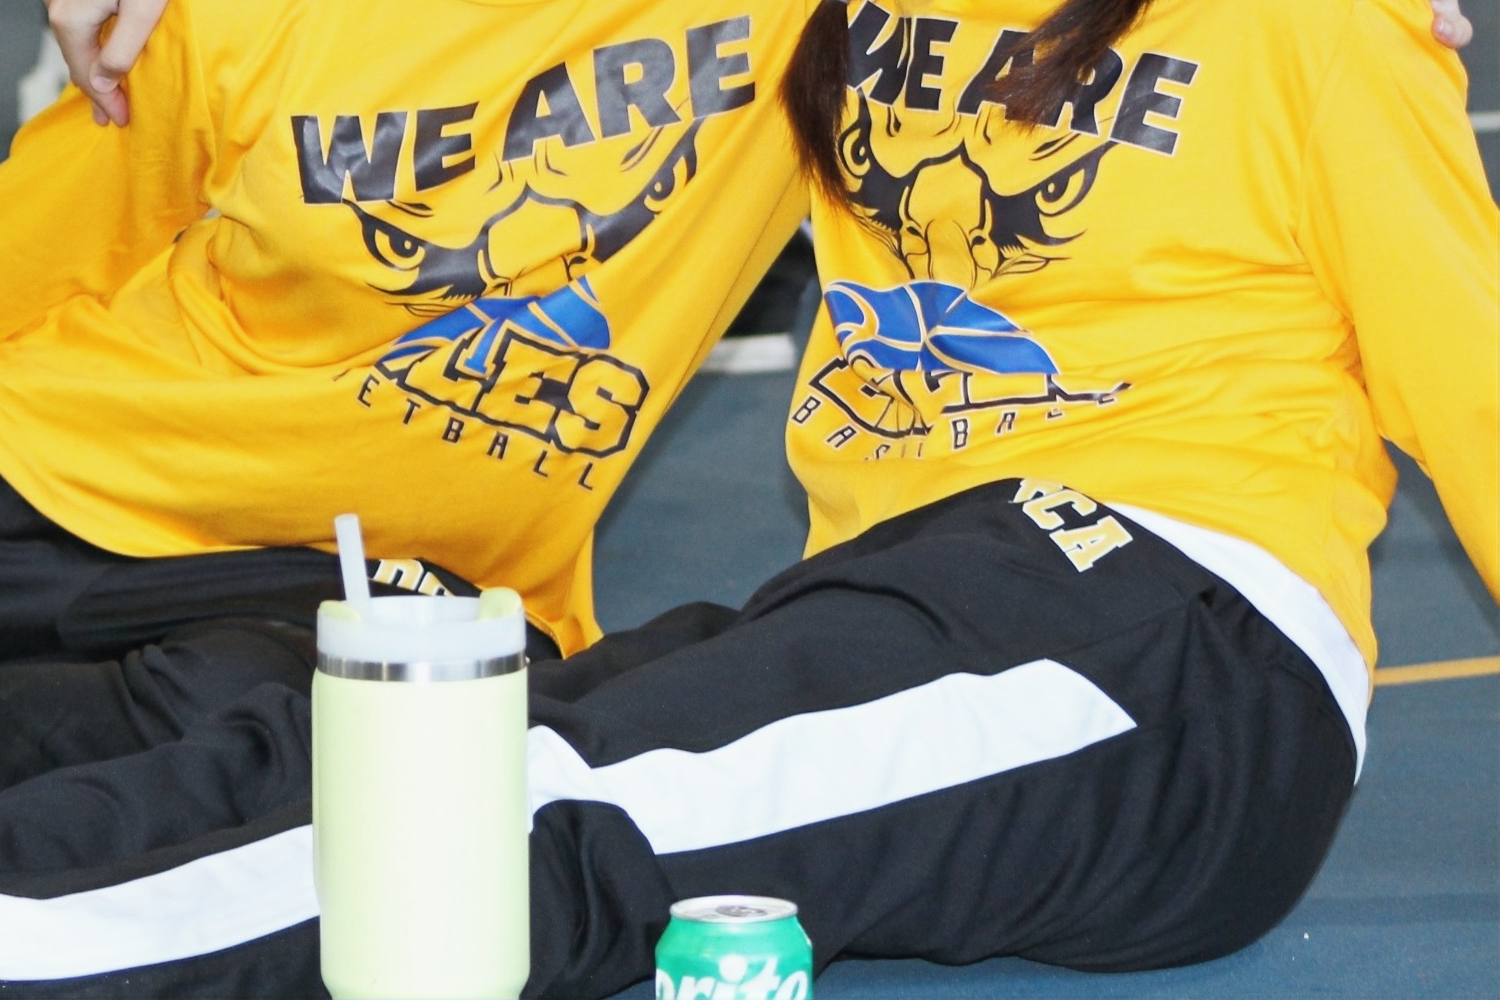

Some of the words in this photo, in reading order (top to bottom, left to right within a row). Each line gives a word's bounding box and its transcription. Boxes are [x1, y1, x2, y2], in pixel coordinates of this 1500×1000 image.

[290, 101, 480, 205] WE
[501, 14, 757, 162] ARE
[350, 372, 594, 491] ETBALL
